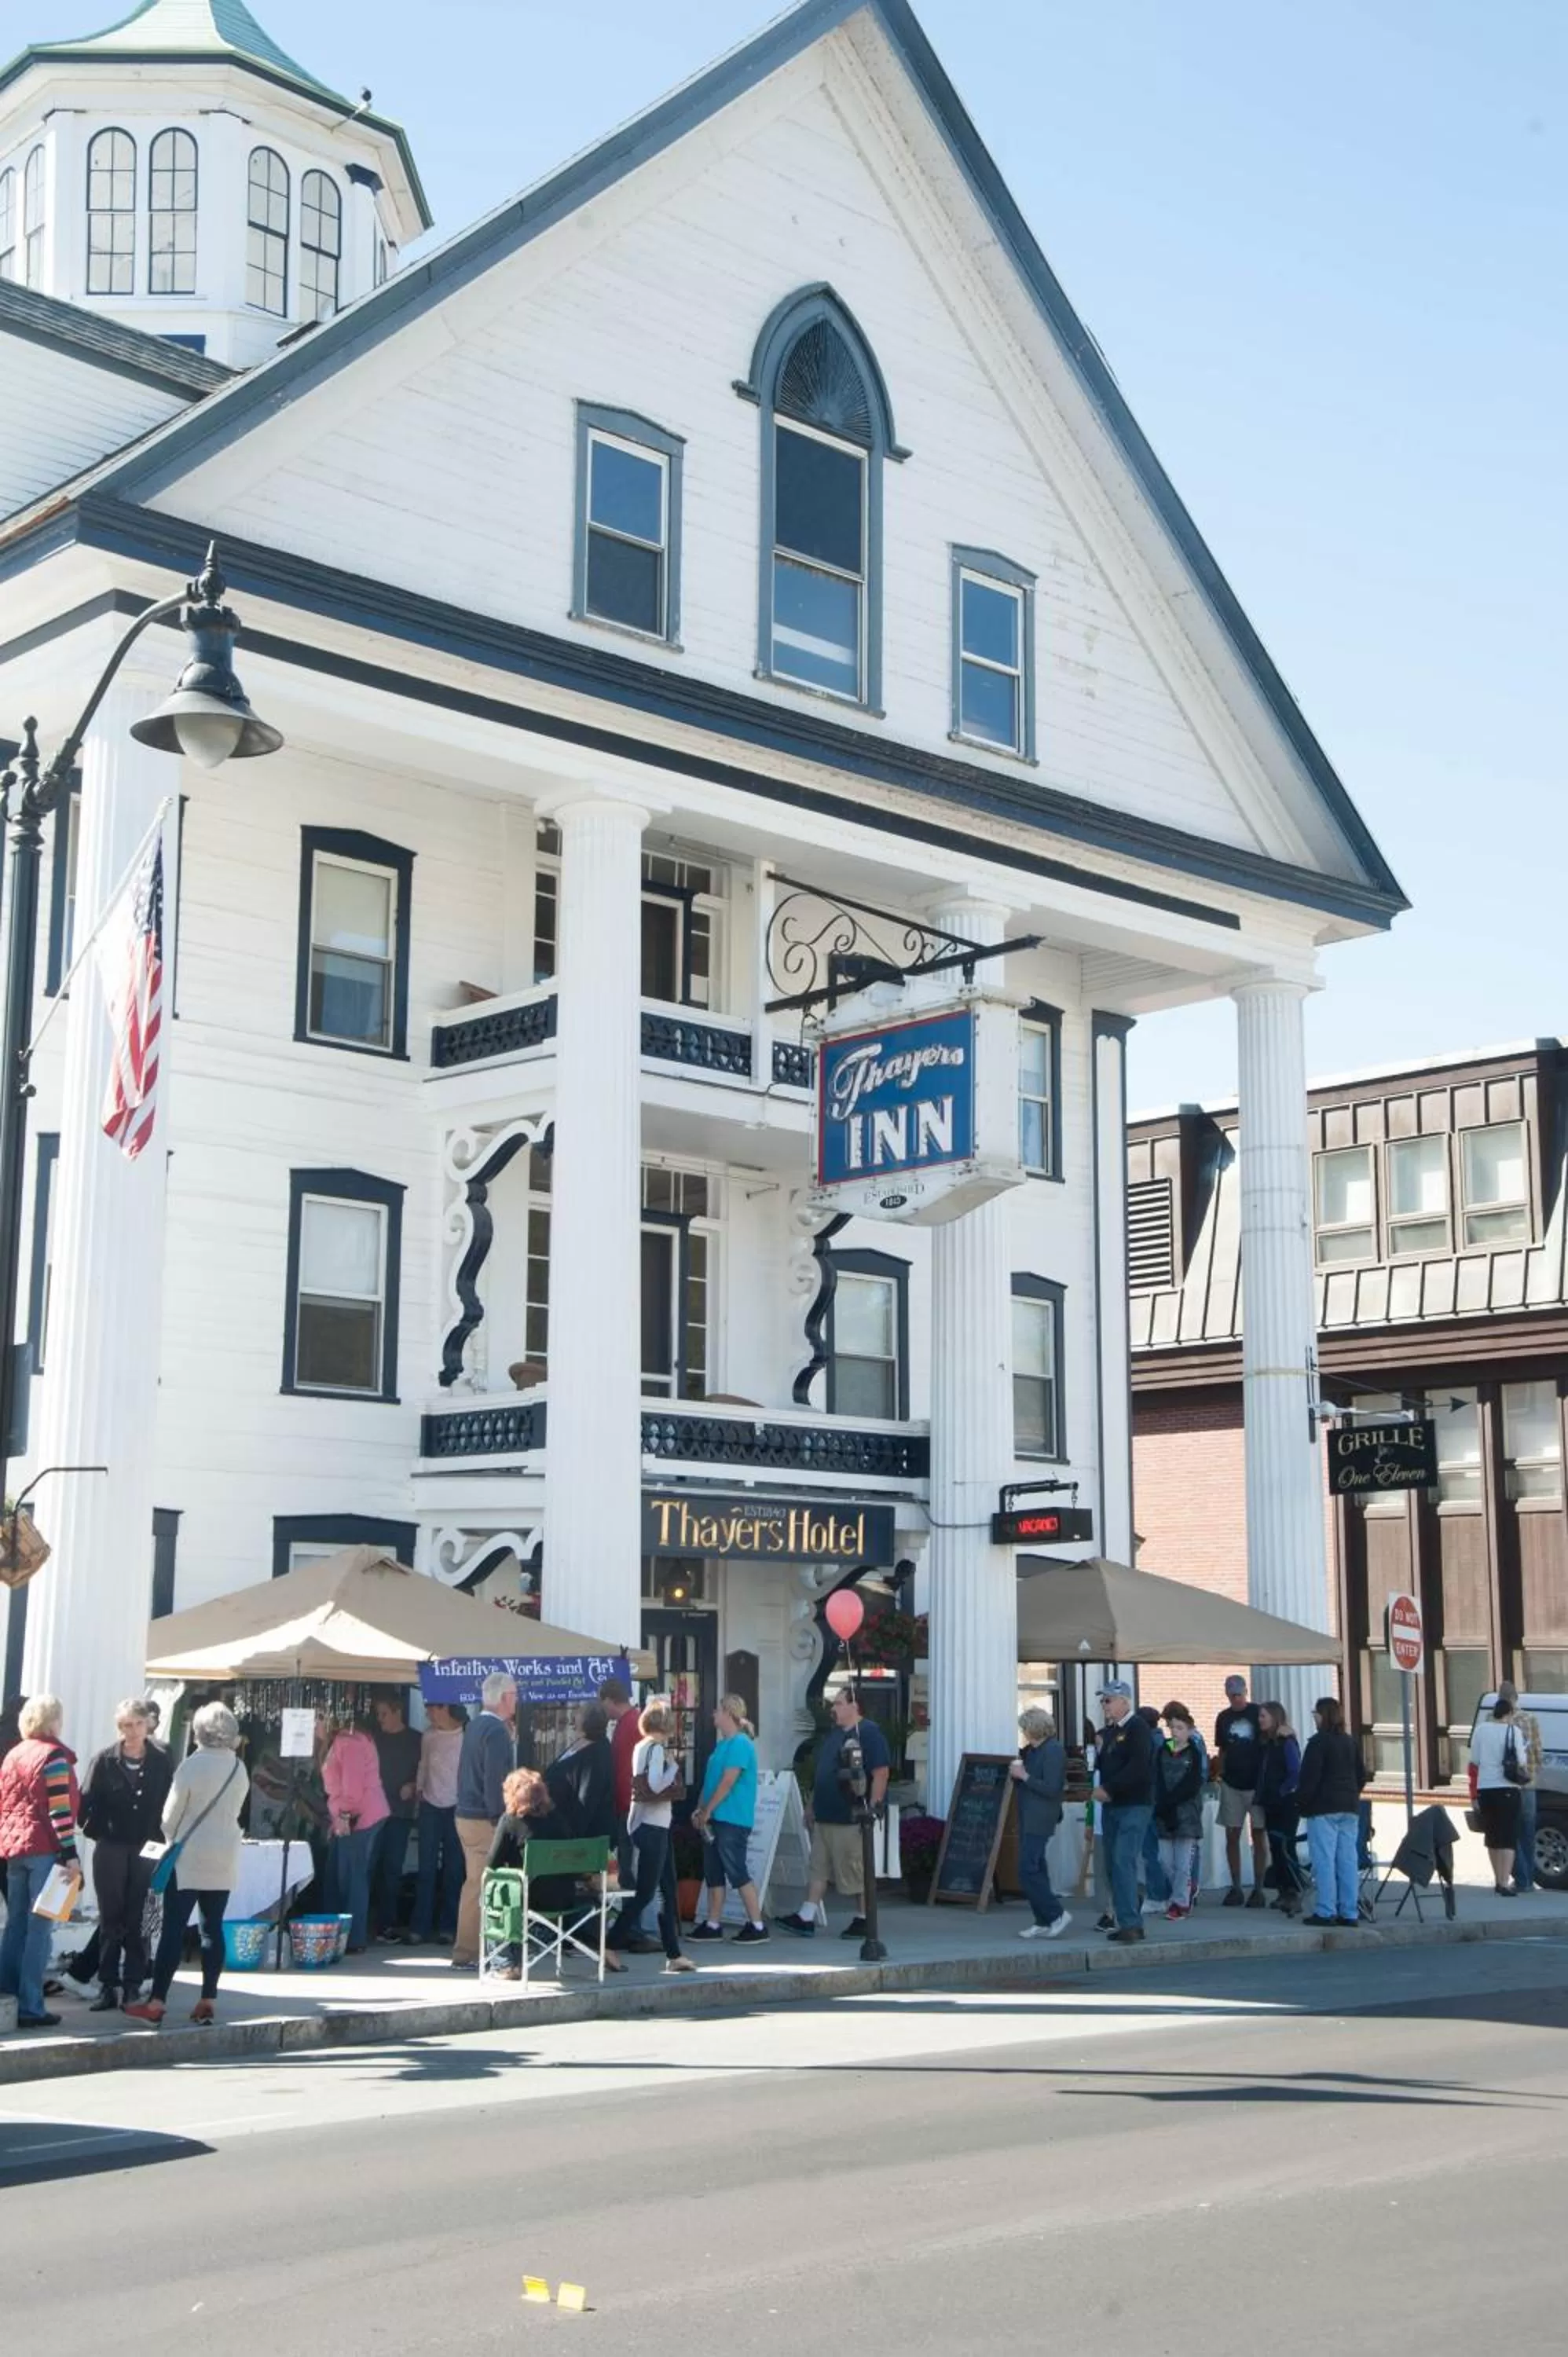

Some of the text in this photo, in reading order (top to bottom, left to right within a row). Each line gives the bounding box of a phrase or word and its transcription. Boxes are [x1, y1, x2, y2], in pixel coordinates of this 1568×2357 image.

[830, 1043, 965, 1120] Thayers
[847, 1096, 953, 1169] INN
[1338, 1427, 1425, 1455] GRILLE
[1338, 1462, 1426, 1489] One Eleven
[650, 1500, 864, 1556] Thayers Hotel
[502, 1658, 551, 1677] Works
[556, 1659, 582, 1675] and
